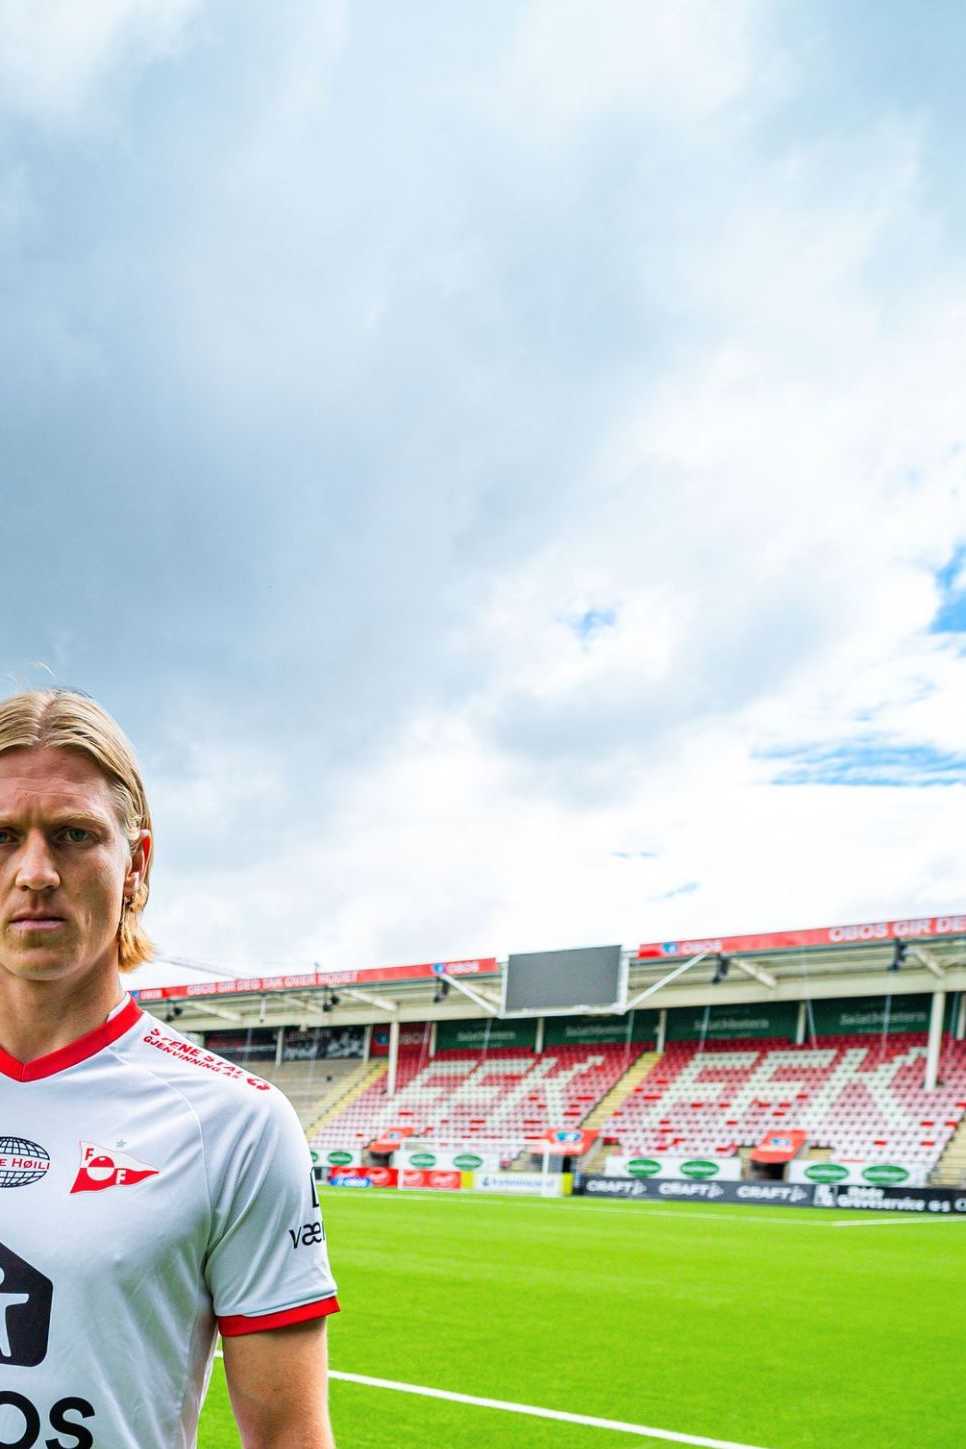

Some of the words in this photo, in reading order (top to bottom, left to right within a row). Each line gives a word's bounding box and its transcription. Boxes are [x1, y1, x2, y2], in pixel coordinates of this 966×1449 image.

[828, 922, 888, 942] OBOS
[893, 917, 934, 937] GIR
[143, 1035, 221, 1073] GJENVINNING
[84, 1147, 95, 1161] F
[11, 1157, 51, 1172] HØILI
[586, 1179, 634, 1194] CRAFT
[659, 1182, 711, 1197] CRAFT
[737, 1184, 792, 1200] CRAFT
[289, 1220, 325, 1250] væ
